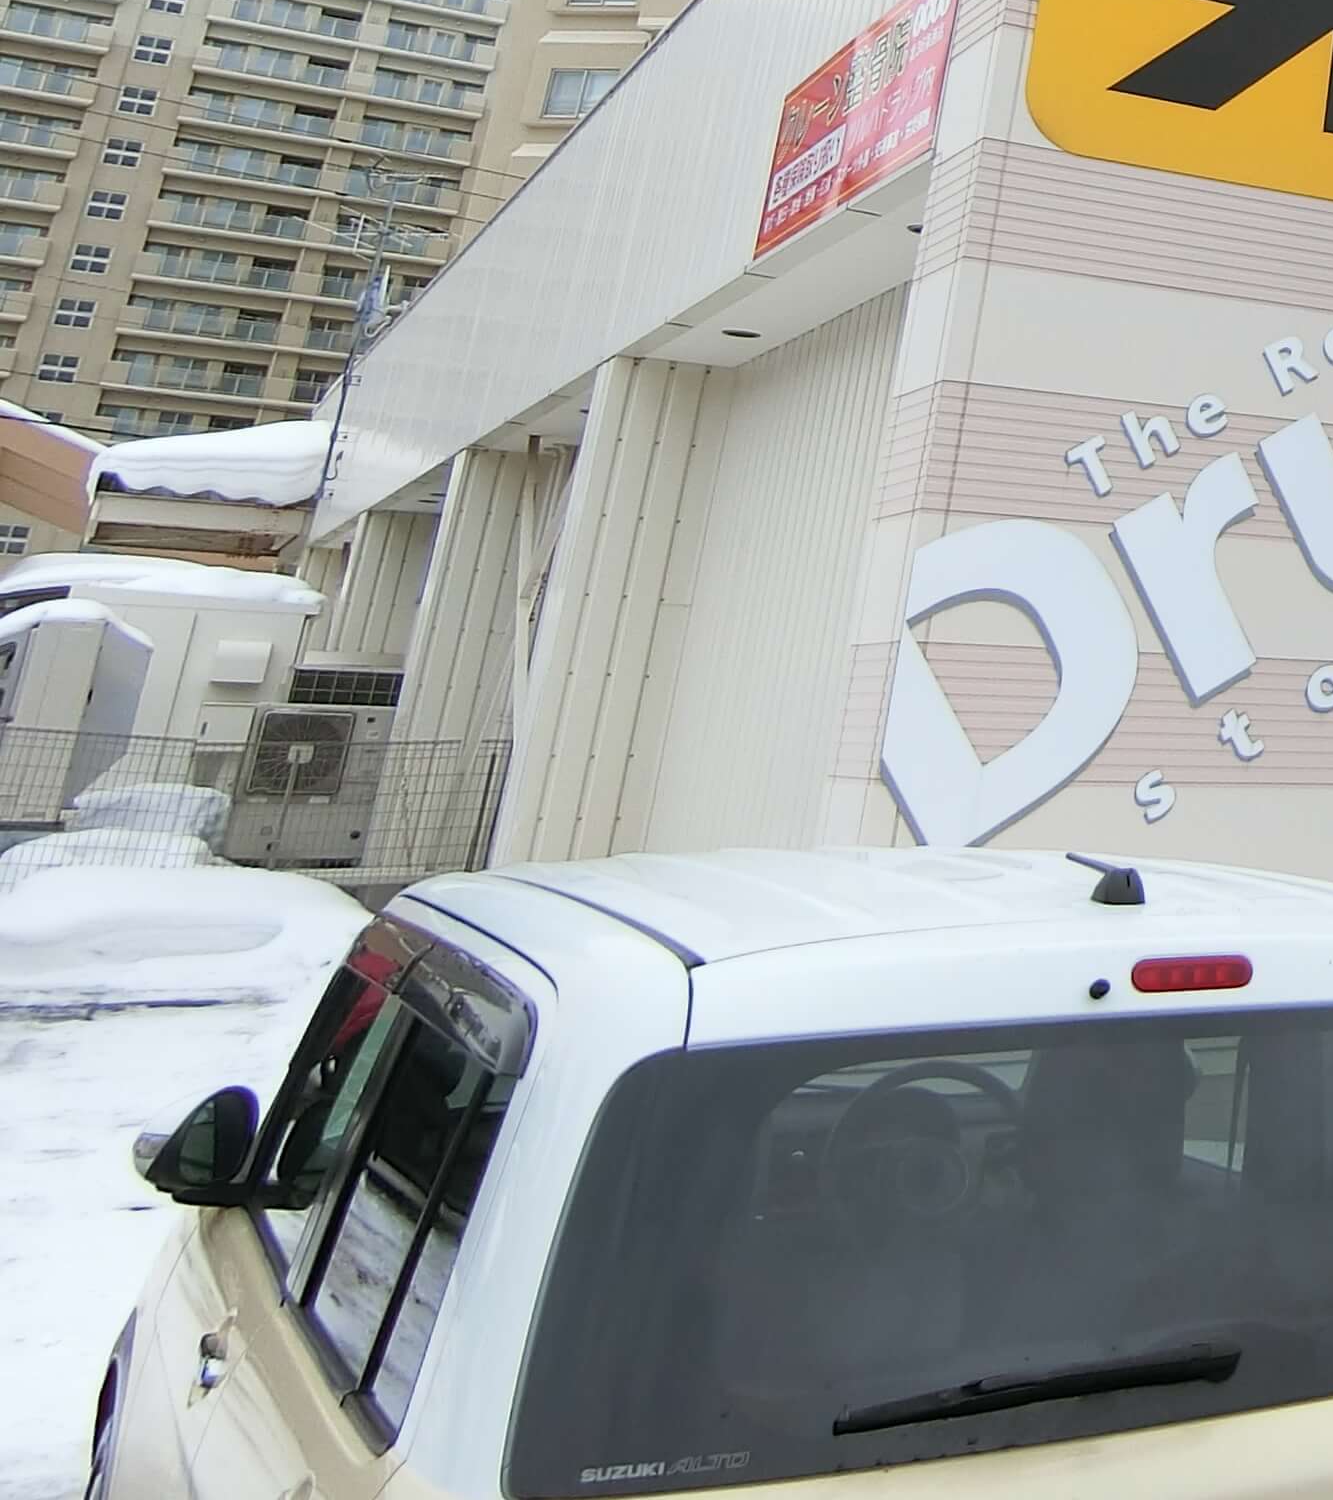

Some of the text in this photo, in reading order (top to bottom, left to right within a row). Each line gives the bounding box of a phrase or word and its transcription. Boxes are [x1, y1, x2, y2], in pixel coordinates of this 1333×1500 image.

[1065, 393, 1229, 498] The
[579, 1451, 751, 1483] SUZUKI ALTO
